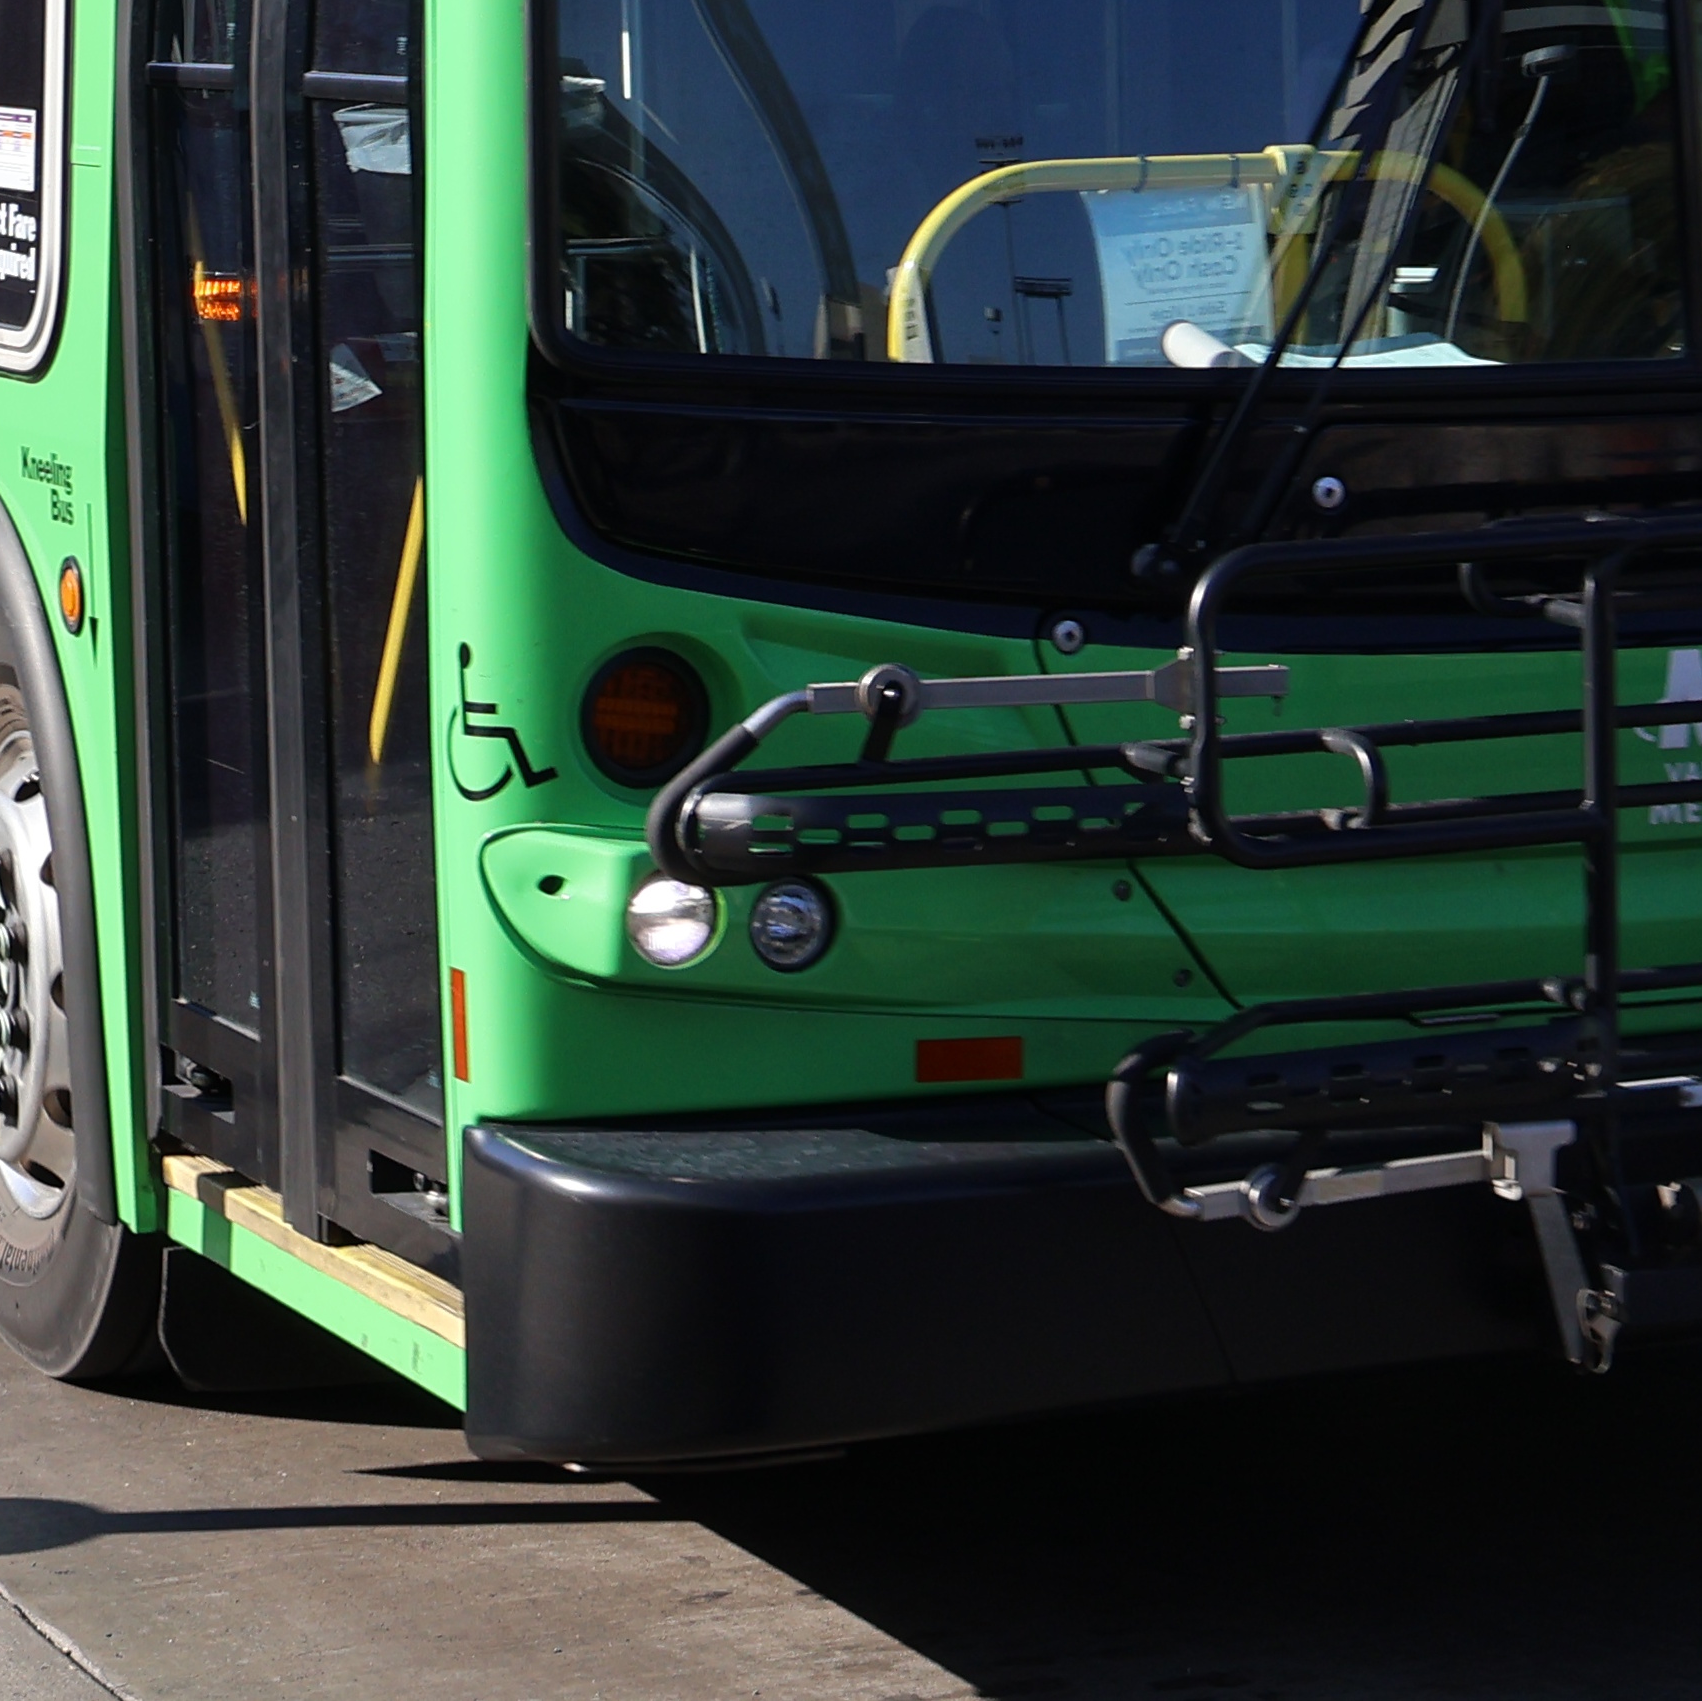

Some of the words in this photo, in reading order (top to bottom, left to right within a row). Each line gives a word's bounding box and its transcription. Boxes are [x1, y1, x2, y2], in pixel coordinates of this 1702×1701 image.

[8, 203, 37, 242] Fare
[21, 446, 73, 495] Kneeling
[51, 489, 74, 525] Bus
